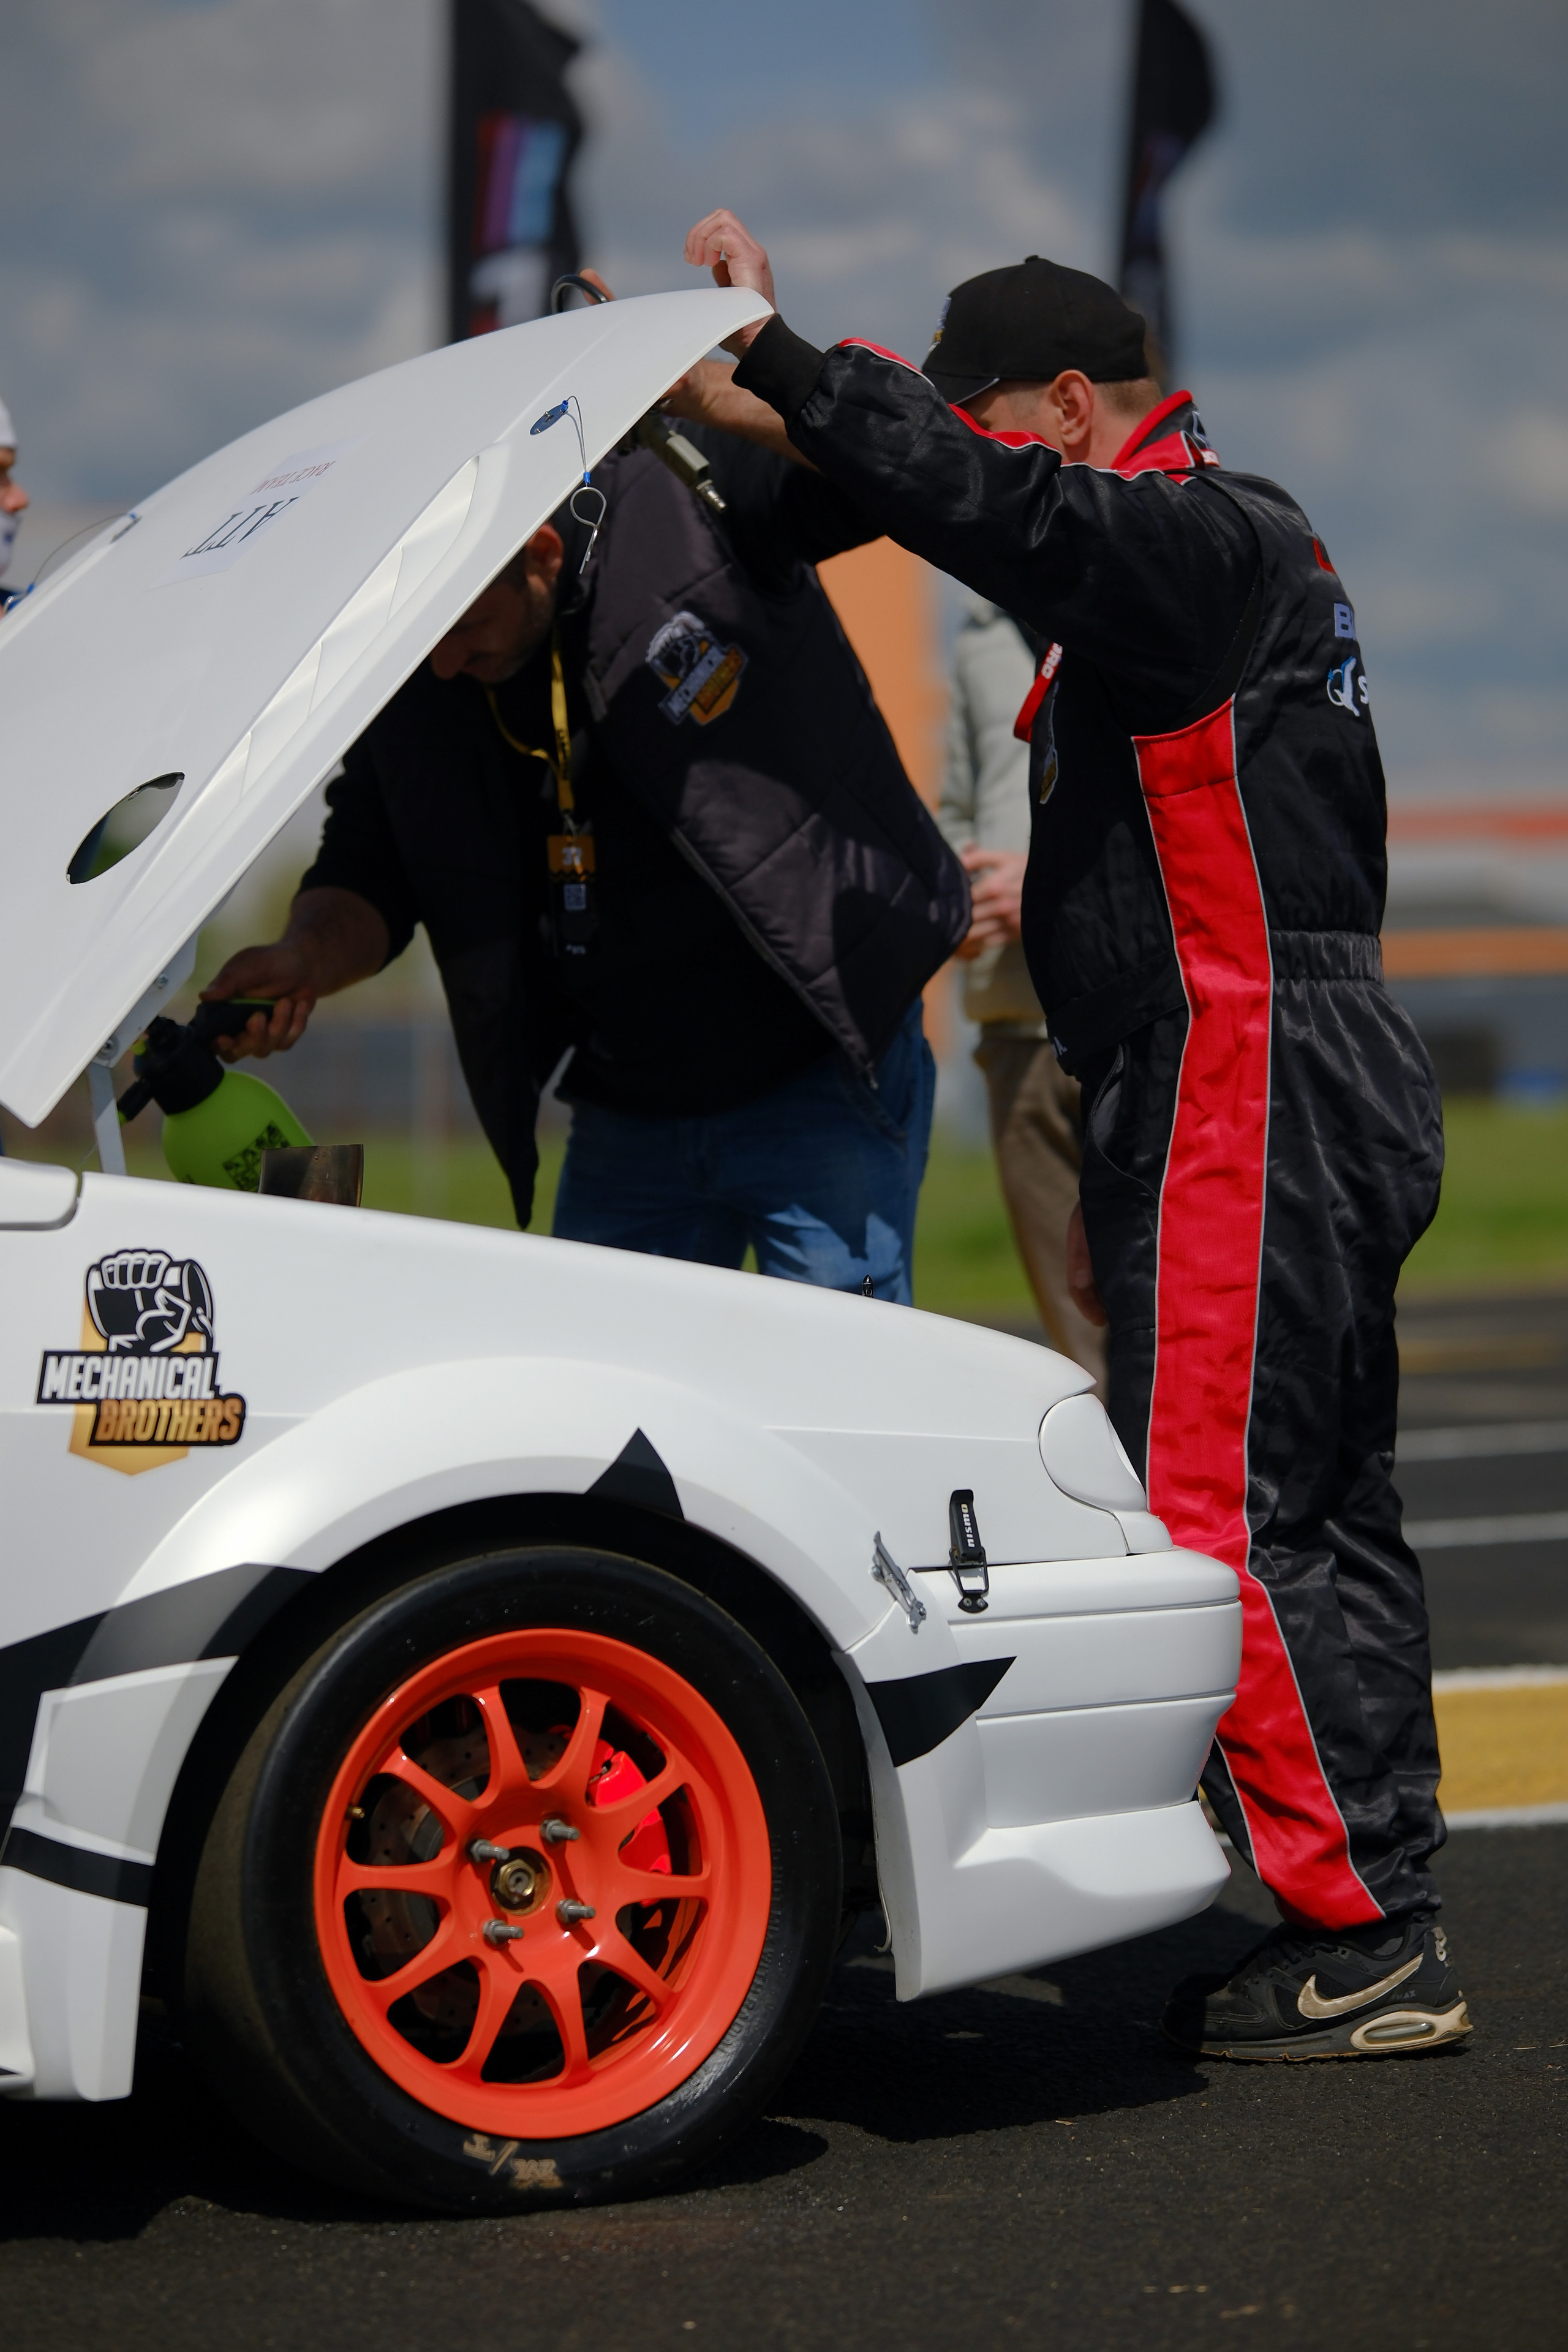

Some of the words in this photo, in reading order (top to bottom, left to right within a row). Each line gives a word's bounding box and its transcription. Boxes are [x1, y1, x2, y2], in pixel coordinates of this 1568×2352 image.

[179, 496, 300, 560] ATT
[41, 1355, 216, 1400] MECHANICAL
[94, 1398, 243, 1442] BROTHERS
